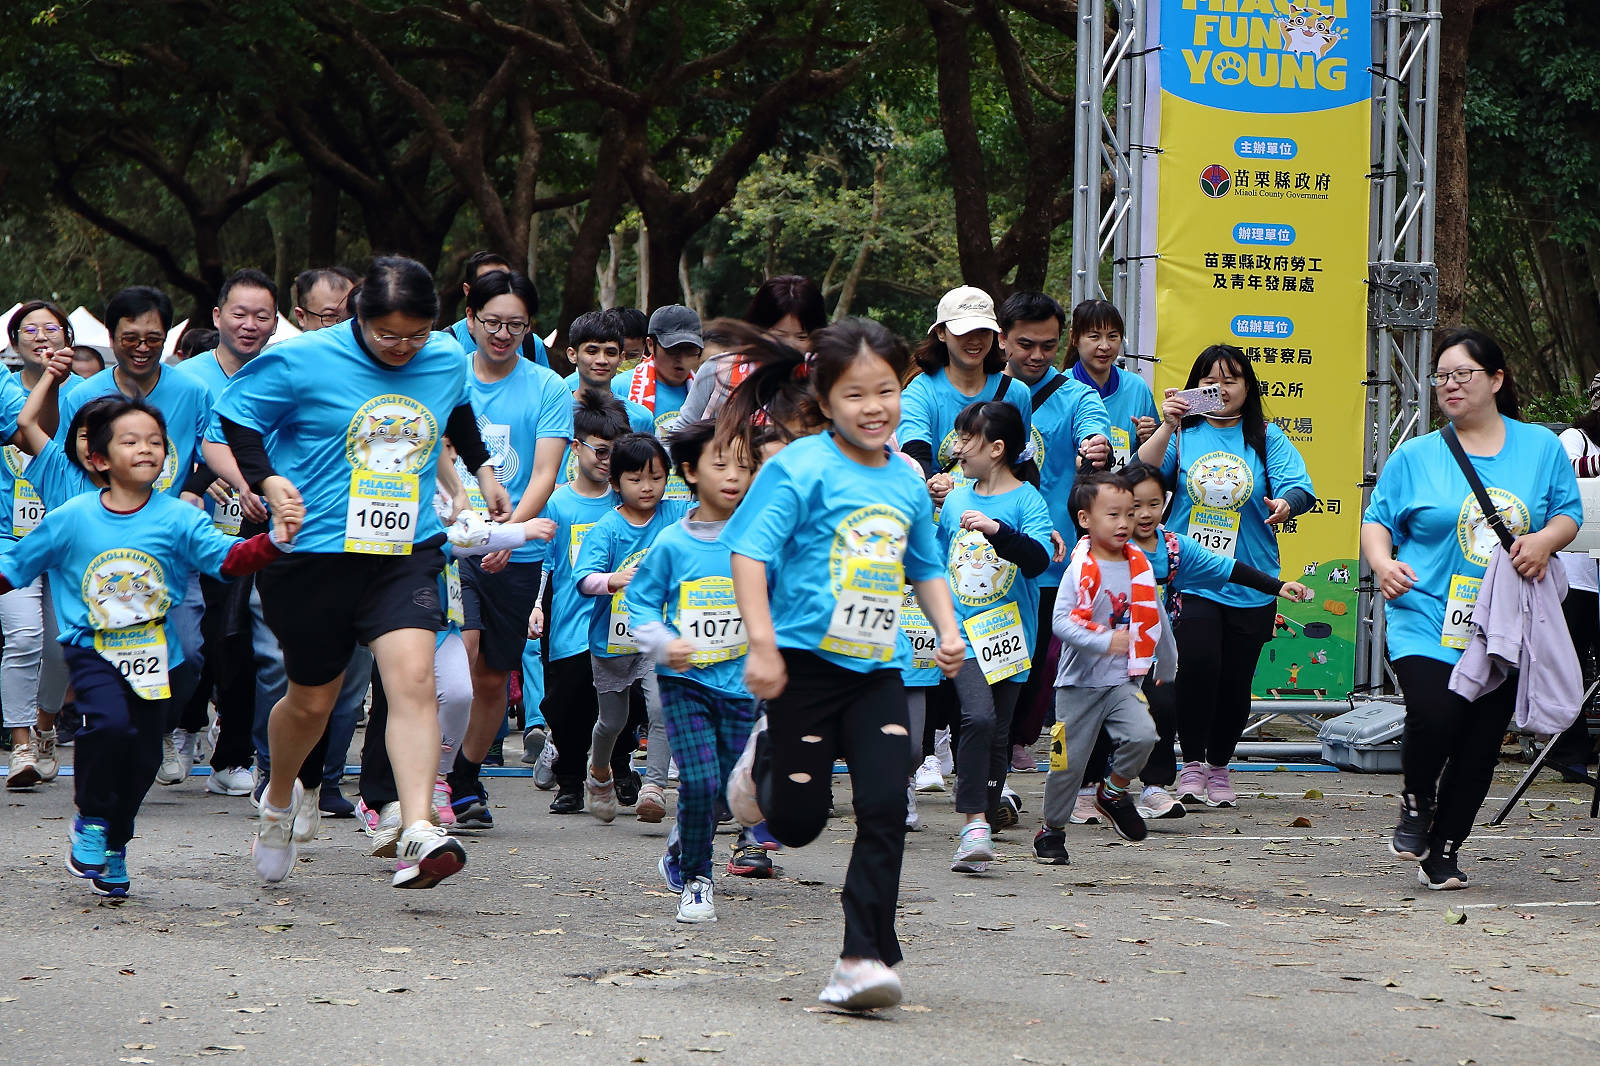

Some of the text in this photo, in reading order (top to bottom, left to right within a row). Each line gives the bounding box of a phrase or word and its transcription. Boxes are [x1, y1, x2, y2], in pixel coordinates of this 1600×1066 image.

[1193, 14, 1282, 50] FUN
[1181, 49, 1348, 91] YOUNG
[1240, 141, 1292, 156] 主辦單位
[1233, 169, 1331, 191] 苗栗縣政府
[1234, 188, 1328, 200] Miaoli County Government
[1238, 227, 1290, 242] 辦理單位
[1204, 253, 1323, 272] 苗栗縣政府勞工
[1213, 274, 1315, 293] 及青年發展處
[1237, 319, 1289, 335] 協辦單位
[1234, 346, 1312, 365] 縣警察局
[363, 396, 395, 415] MIAOLI
[399, 397, 419, 410] FUN
[1264, 416, 1312, 434] 牧場
[1199, 453, 1224, 464] MIAOLI
[1225, 454, 1239, 463] FUN
[358, 489, 412, 499] FUN YOUNG
[359, 479, 405, 491] MIAOLI
[357, 508, 410, 530] 1060
[1195, 511, 1228, 523] MIAOLI
[1512, 499, 1529, 528] YOUNG
[1194, 517, 1233, 529] FUN YOUNG
[1192, 532, 1232, 551] 0137
[972, 590, 1005, 605] MIAOLI
[844, 604, 895, 631] 1179
[972, 613, 1008, 630] MIAOLI
[1451, 609, 1478, 627] 04
[102, 630, 147, 641] MIAOLI
[690, 617, 743, 638] 1077
[974, 626, 990, 637] FUN
[991, 618, 1016, 632] YOUNG
[982, 635, 1022, 662] 0482
